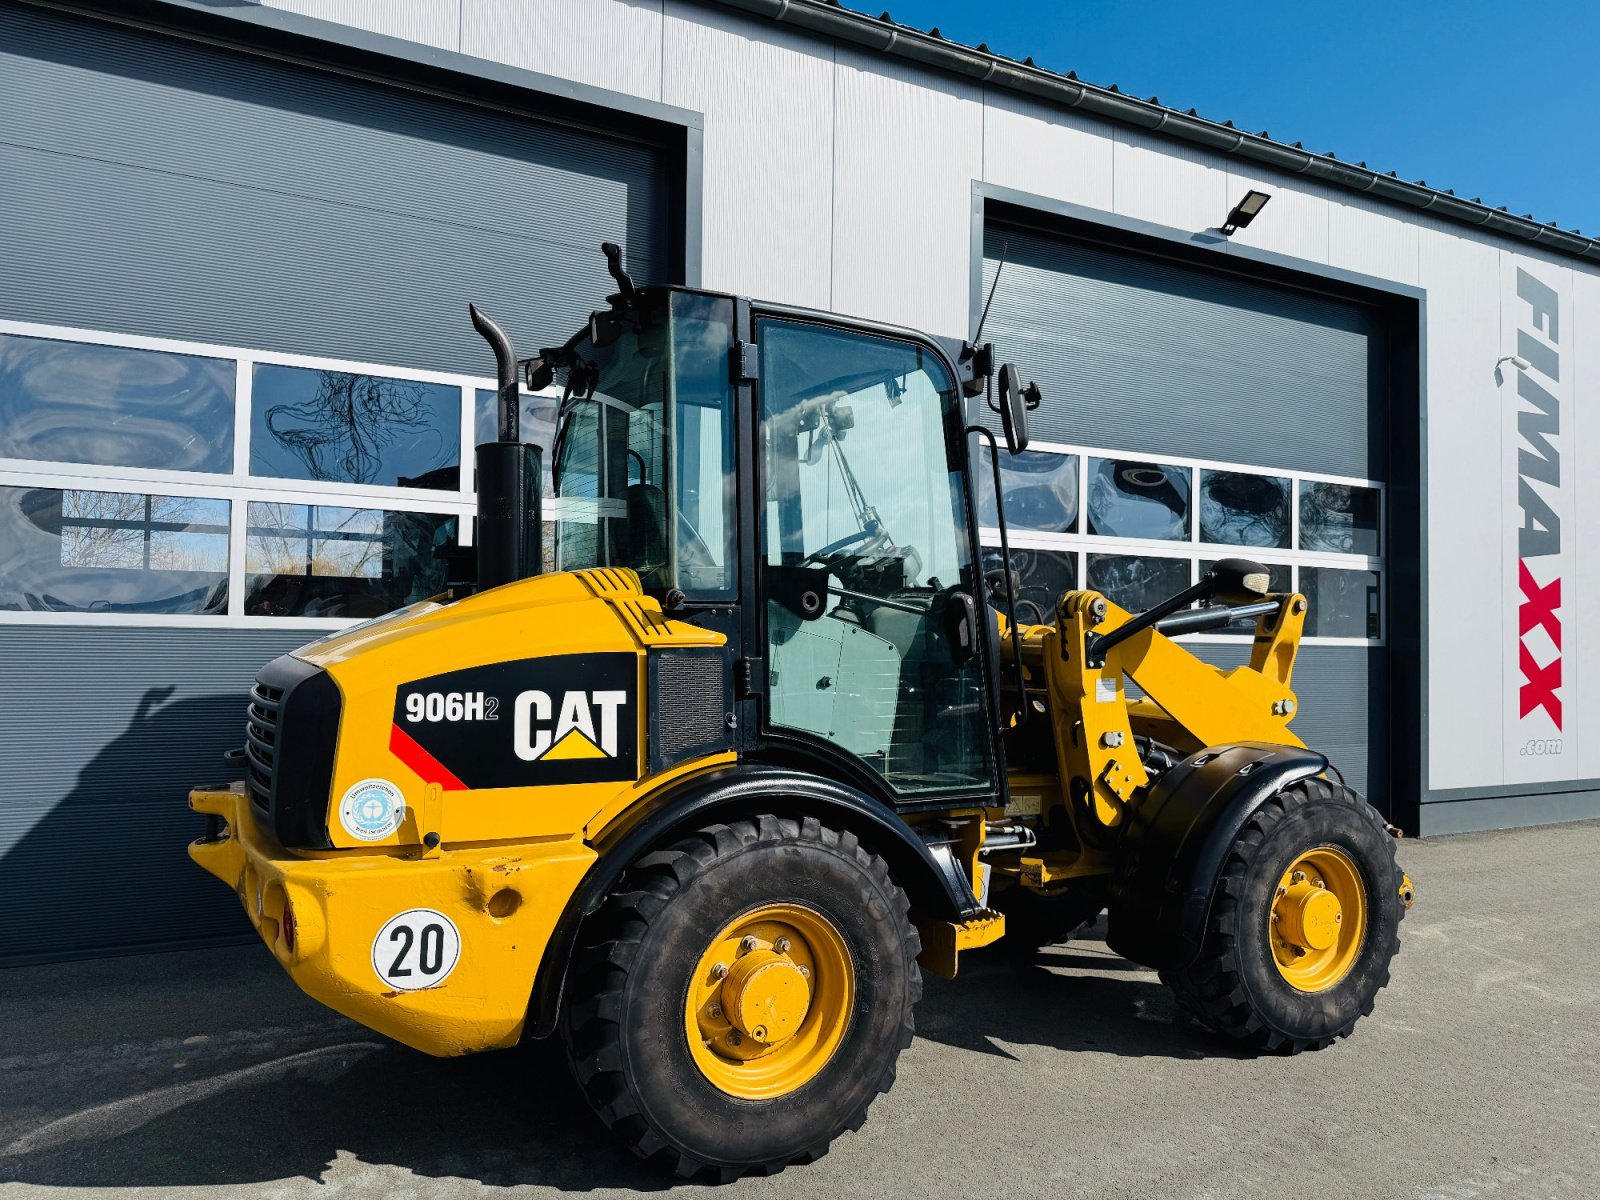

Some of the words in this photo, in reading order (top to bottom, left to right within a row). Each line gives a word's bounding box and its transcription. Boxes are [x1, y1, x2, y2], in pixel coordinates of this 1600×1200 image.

[1516, 266, 1563, 732] FIMAXX
[405, 691, 500, 723] 906H2
[513, 689, 627, 762] CAT
[1519, 738, 1563, 756] .com
[388, 923, 445, 978] 20
